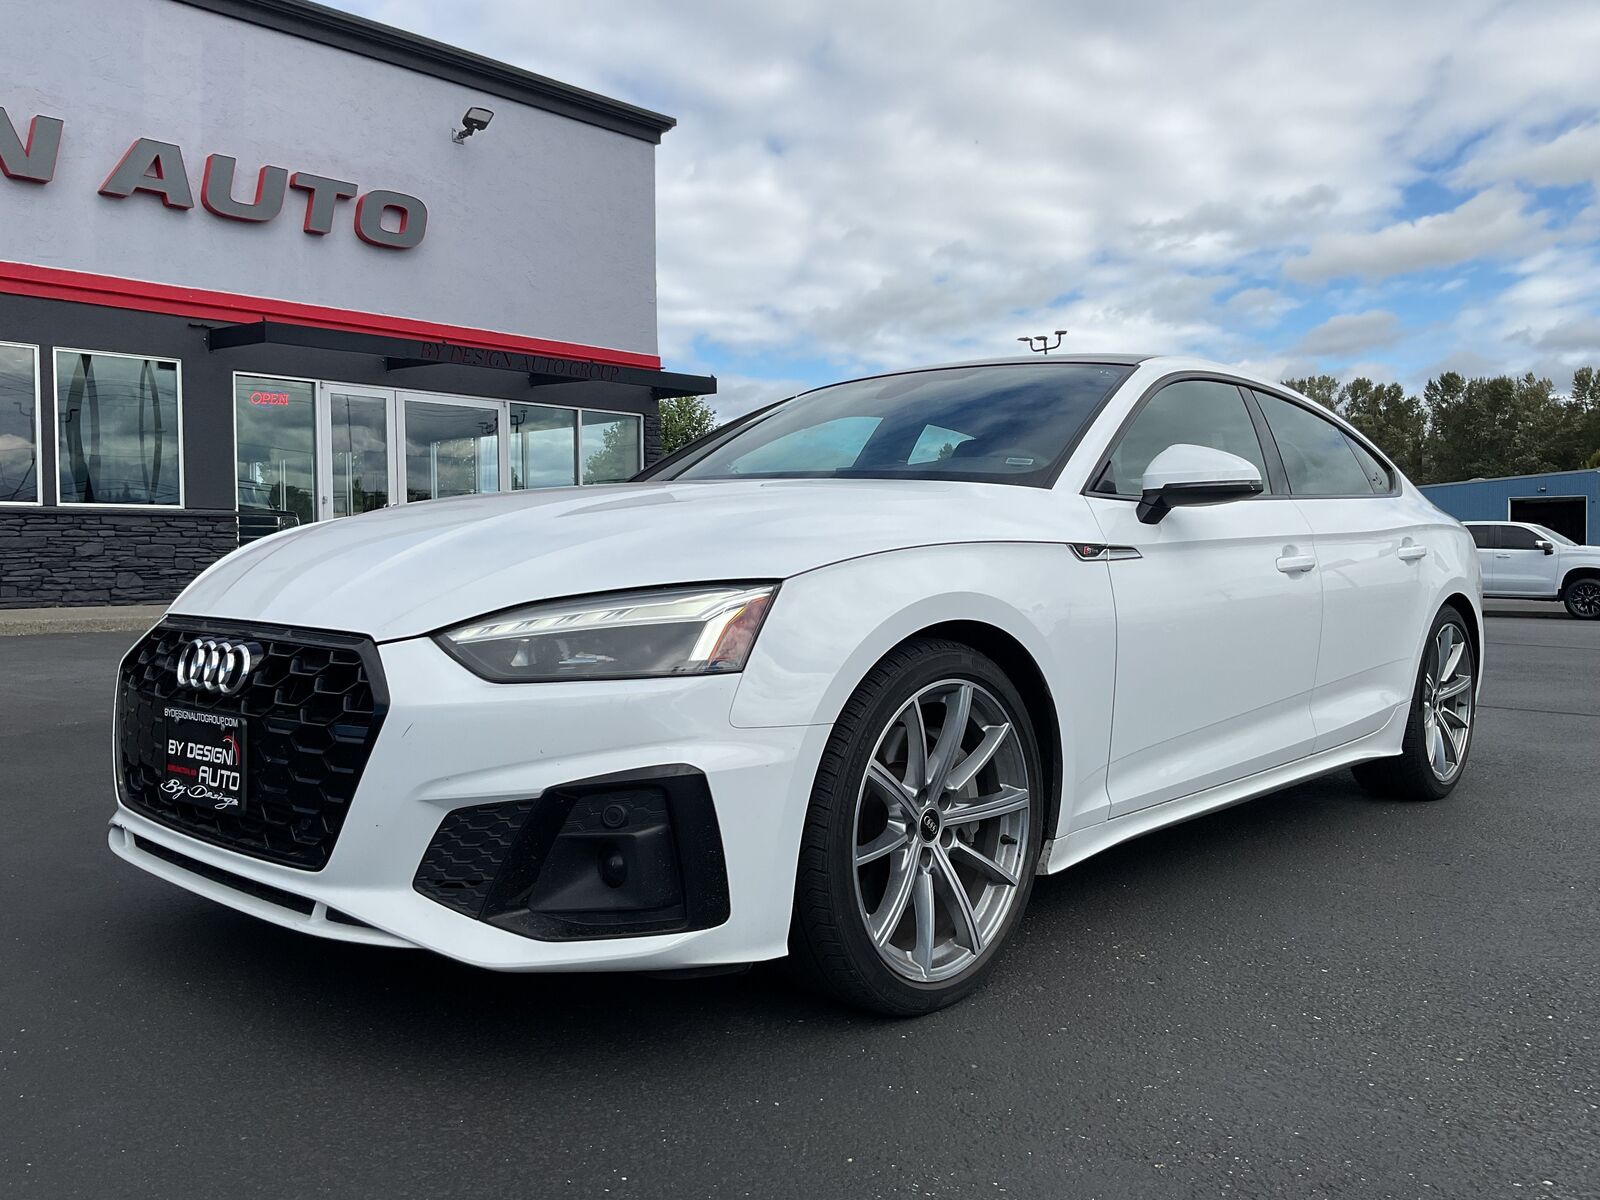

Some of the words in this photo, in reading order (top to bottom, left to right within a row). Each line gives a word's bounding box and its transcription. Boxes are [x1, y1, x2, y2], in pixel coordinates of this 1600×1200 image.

[97, 137, 428, 249] AUTO
[421, 343, 443, 358] BY
[450, 345, 512, 368] DESIGN
[520, 355, 565, 376] AUTO
[570, 360, 620, 380] GROUP
[249, 391, 288, 405] OPEN
[164, 708, 239, 727] BYDESIGNAUTOGROUP.COM
[168, 739, 184, 756] BY
[187, 742, 233, 765] DESIGN
[160, 779, 186, 799] By
[198, 765, 240, 790] AUTO
